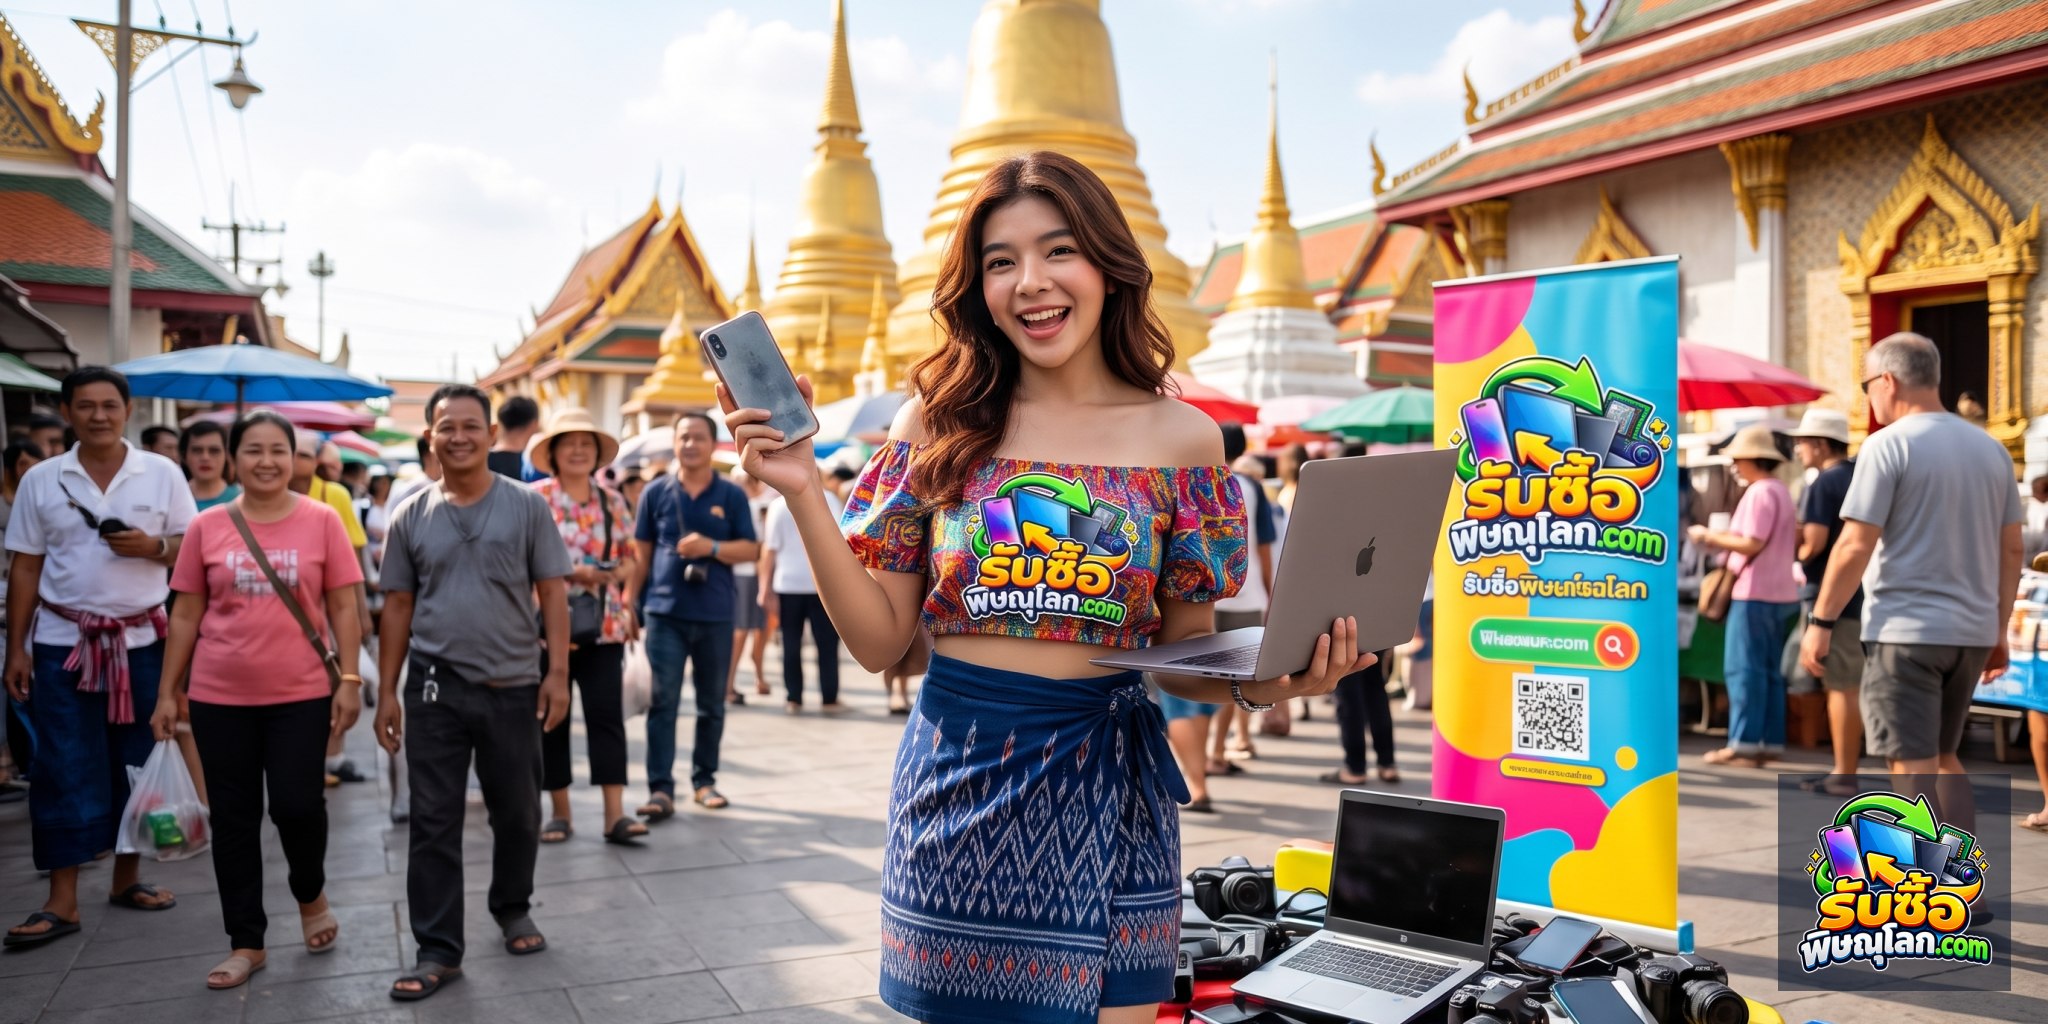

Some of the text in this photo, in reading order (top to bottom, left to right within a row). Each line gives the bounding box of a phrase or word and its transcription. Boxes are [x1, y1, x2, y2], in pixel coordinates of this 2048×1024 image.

[1466, 452, 1637, 522] รับซื้อ
[1451, 512, 1663, 557] พิษณุโลก.com
[979, 541, 1111, 595] รับซื้อ
[965, 584, 1124, 621] พิษณุโลก.com
